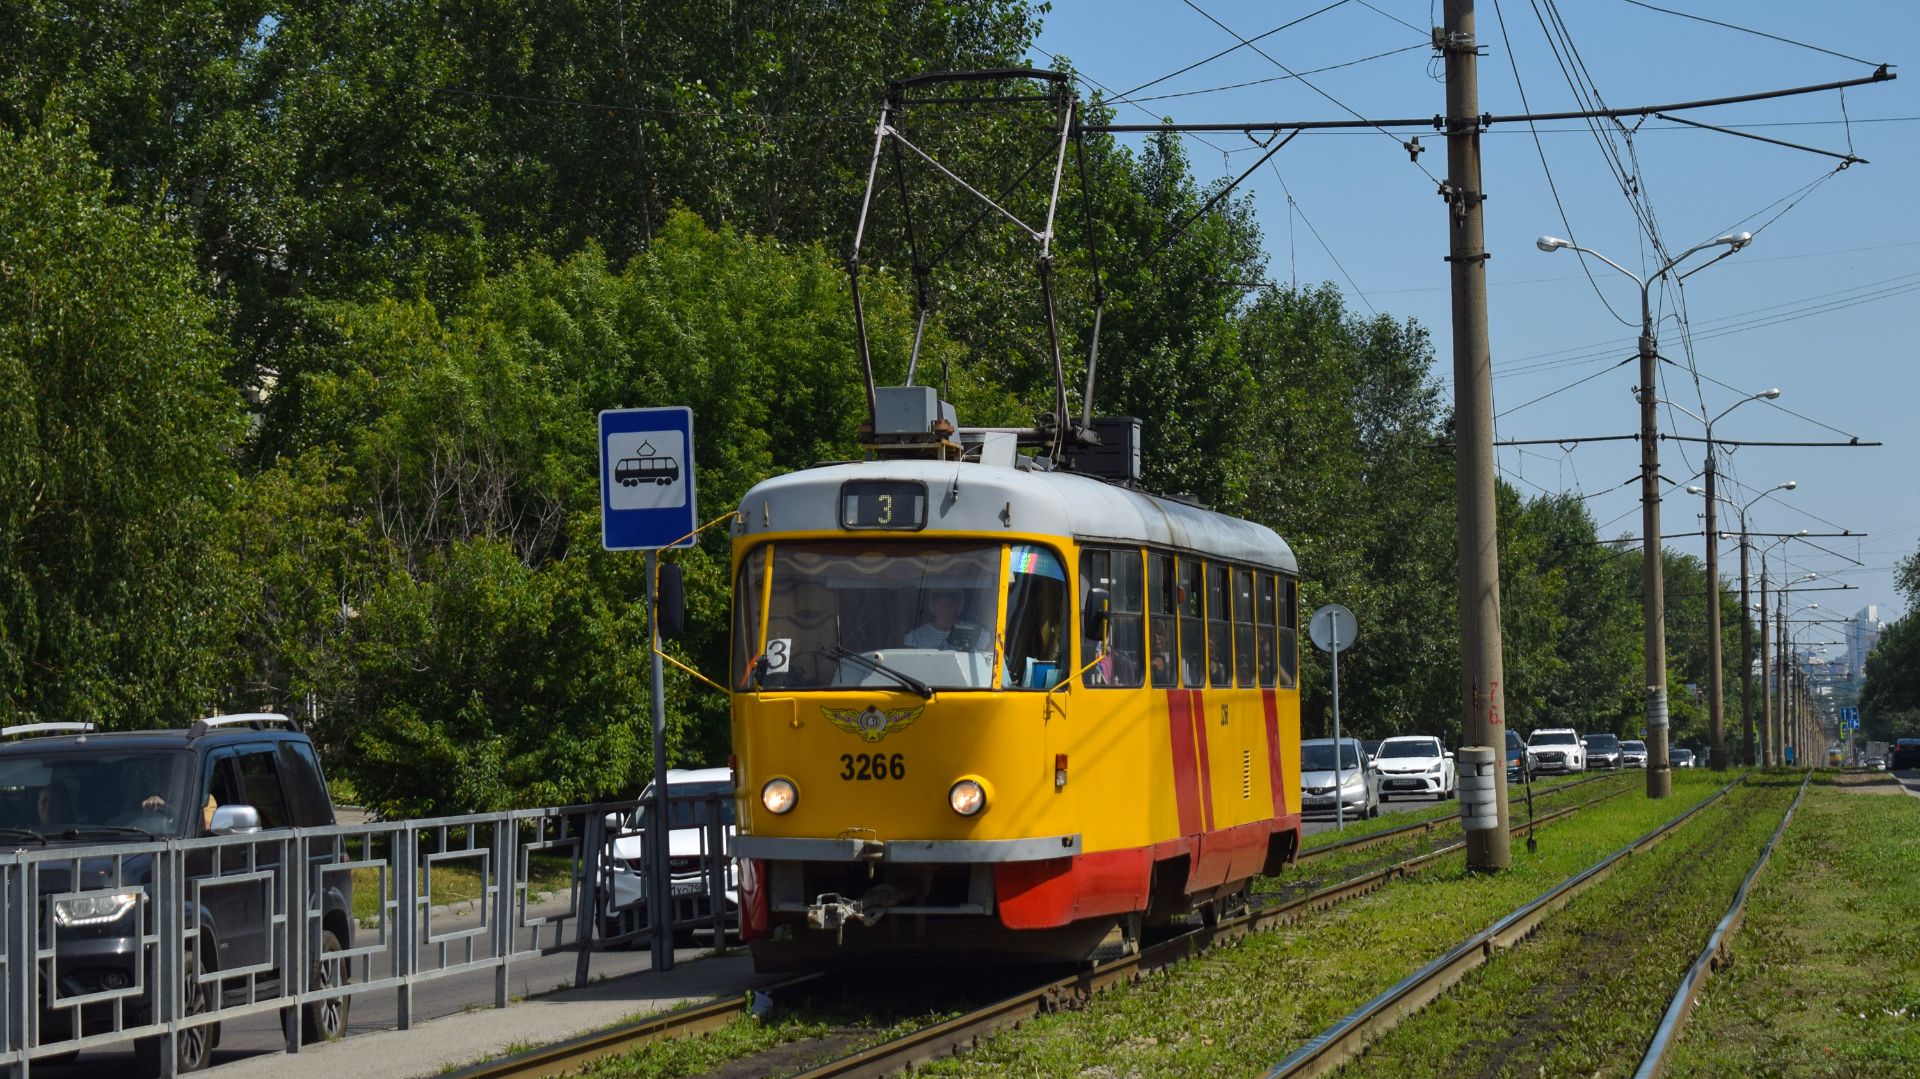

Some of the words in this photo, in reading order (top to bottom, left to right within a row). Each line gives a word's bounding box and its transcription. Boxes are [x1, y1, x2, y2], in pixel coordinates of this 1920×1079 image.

[878, 494, 892, 524] 3
[767, 640, 787, 670] 3
[840, 752, 906, 781] 3266
